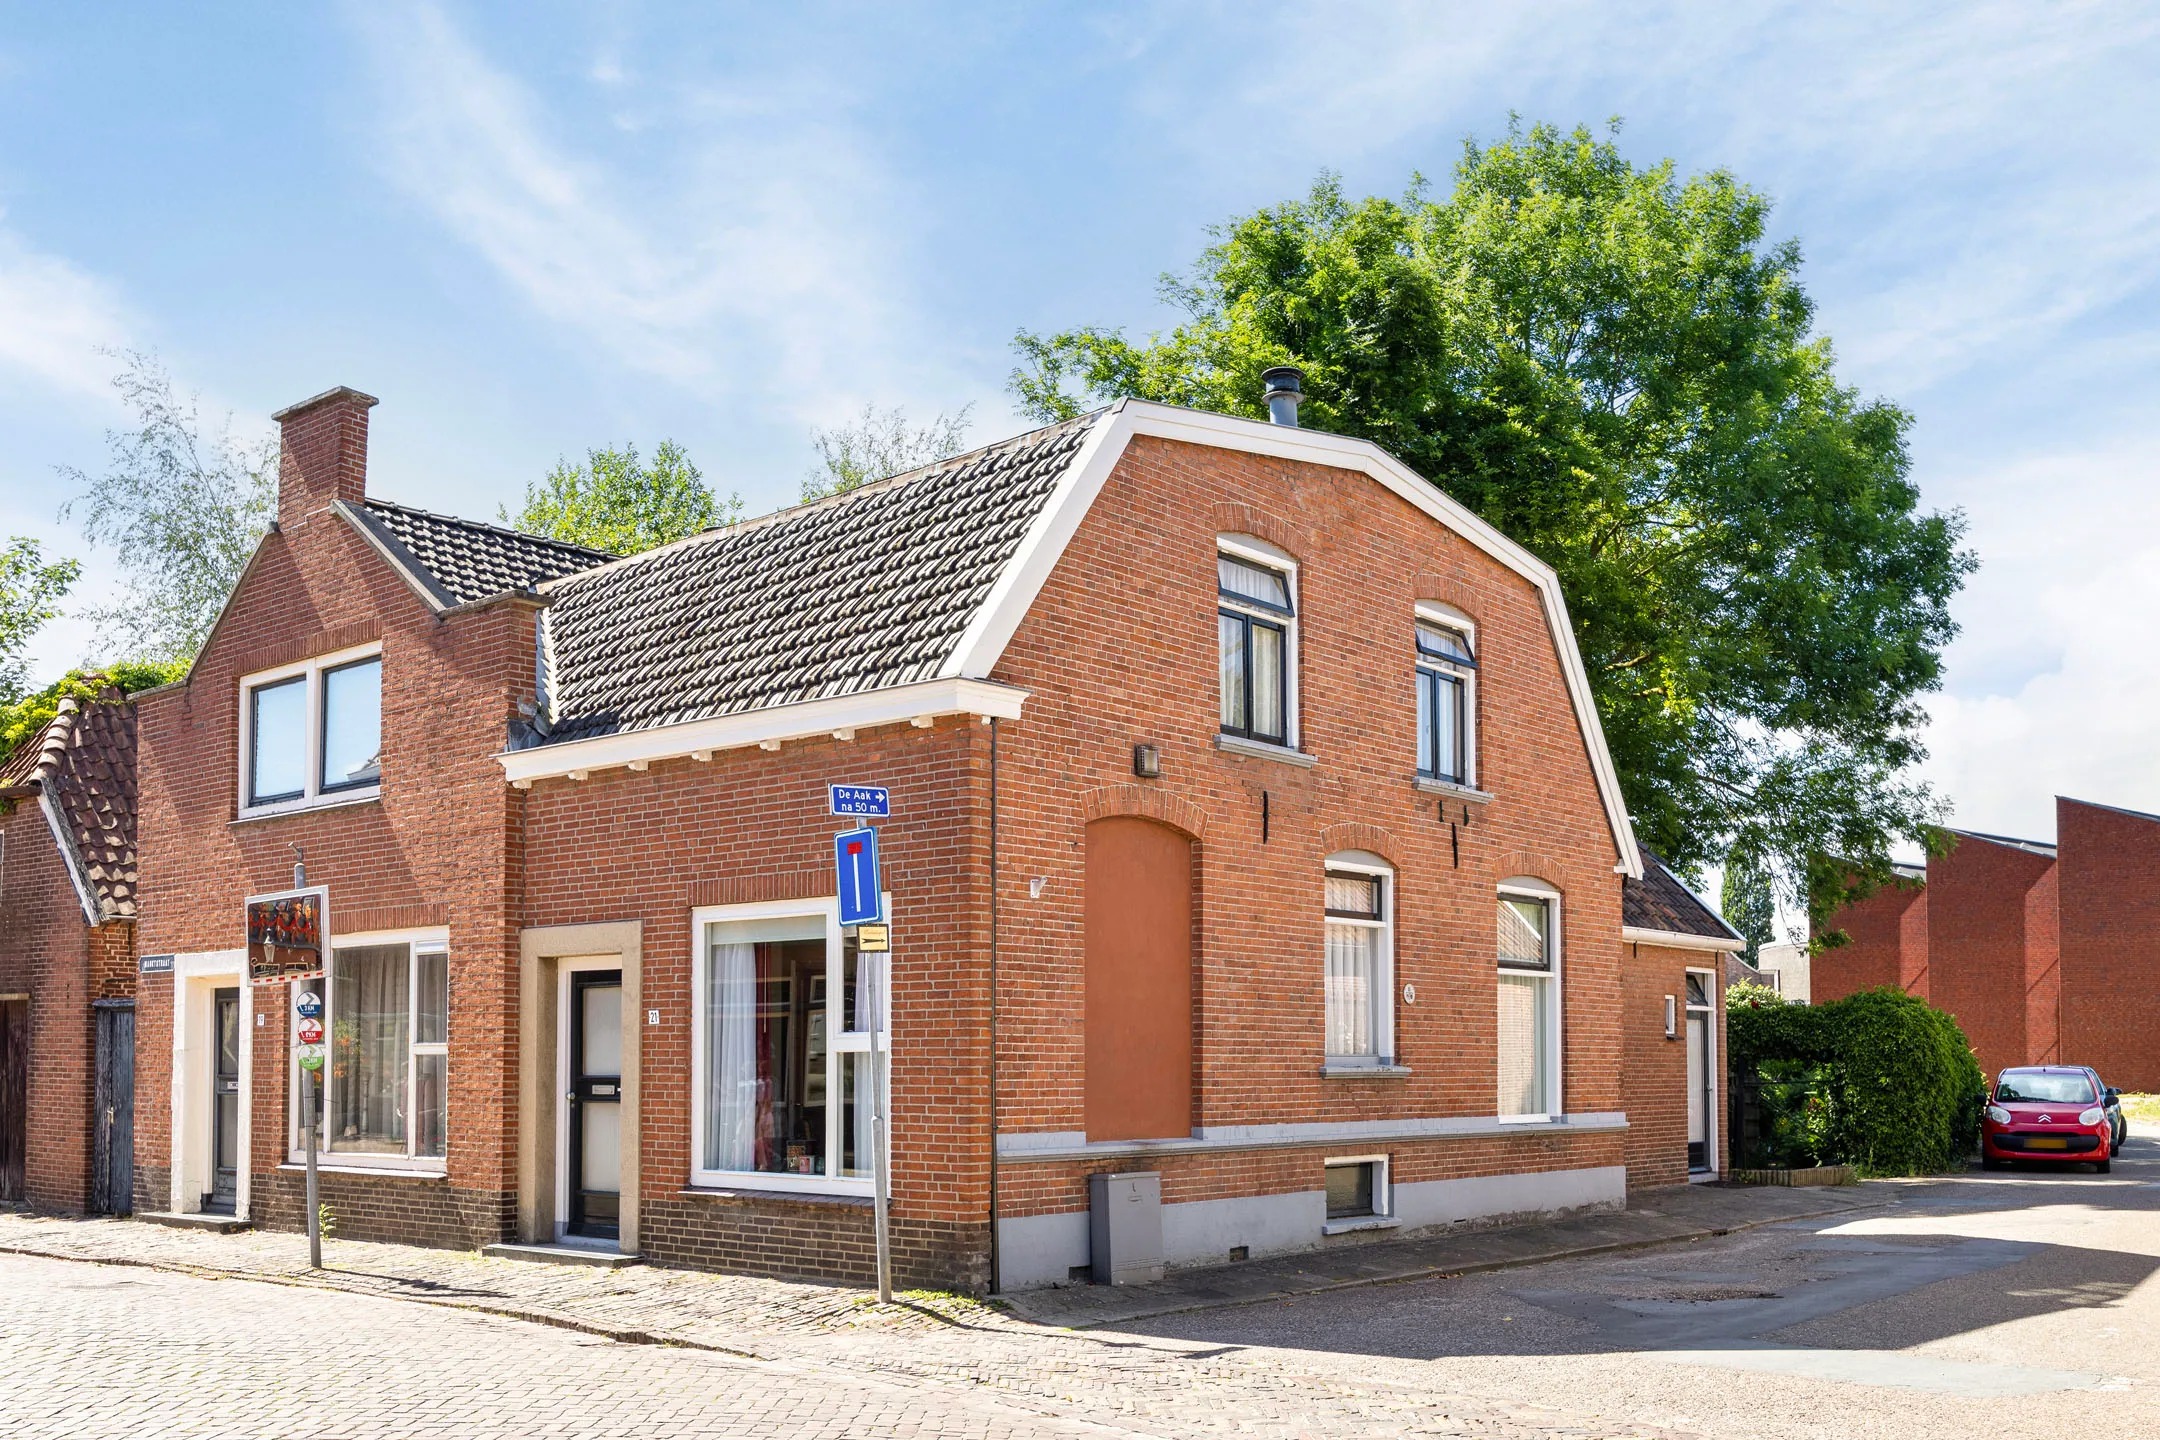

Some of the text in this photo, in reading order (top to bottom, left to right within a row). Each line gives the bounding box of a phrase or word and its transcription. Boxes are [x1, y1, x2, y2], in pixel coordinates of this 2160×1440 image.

[838, 788, 871, 800] De Aak
[841, 802, 881, 813] na 50 m.
[650, 1011, 658, 1023] 21
